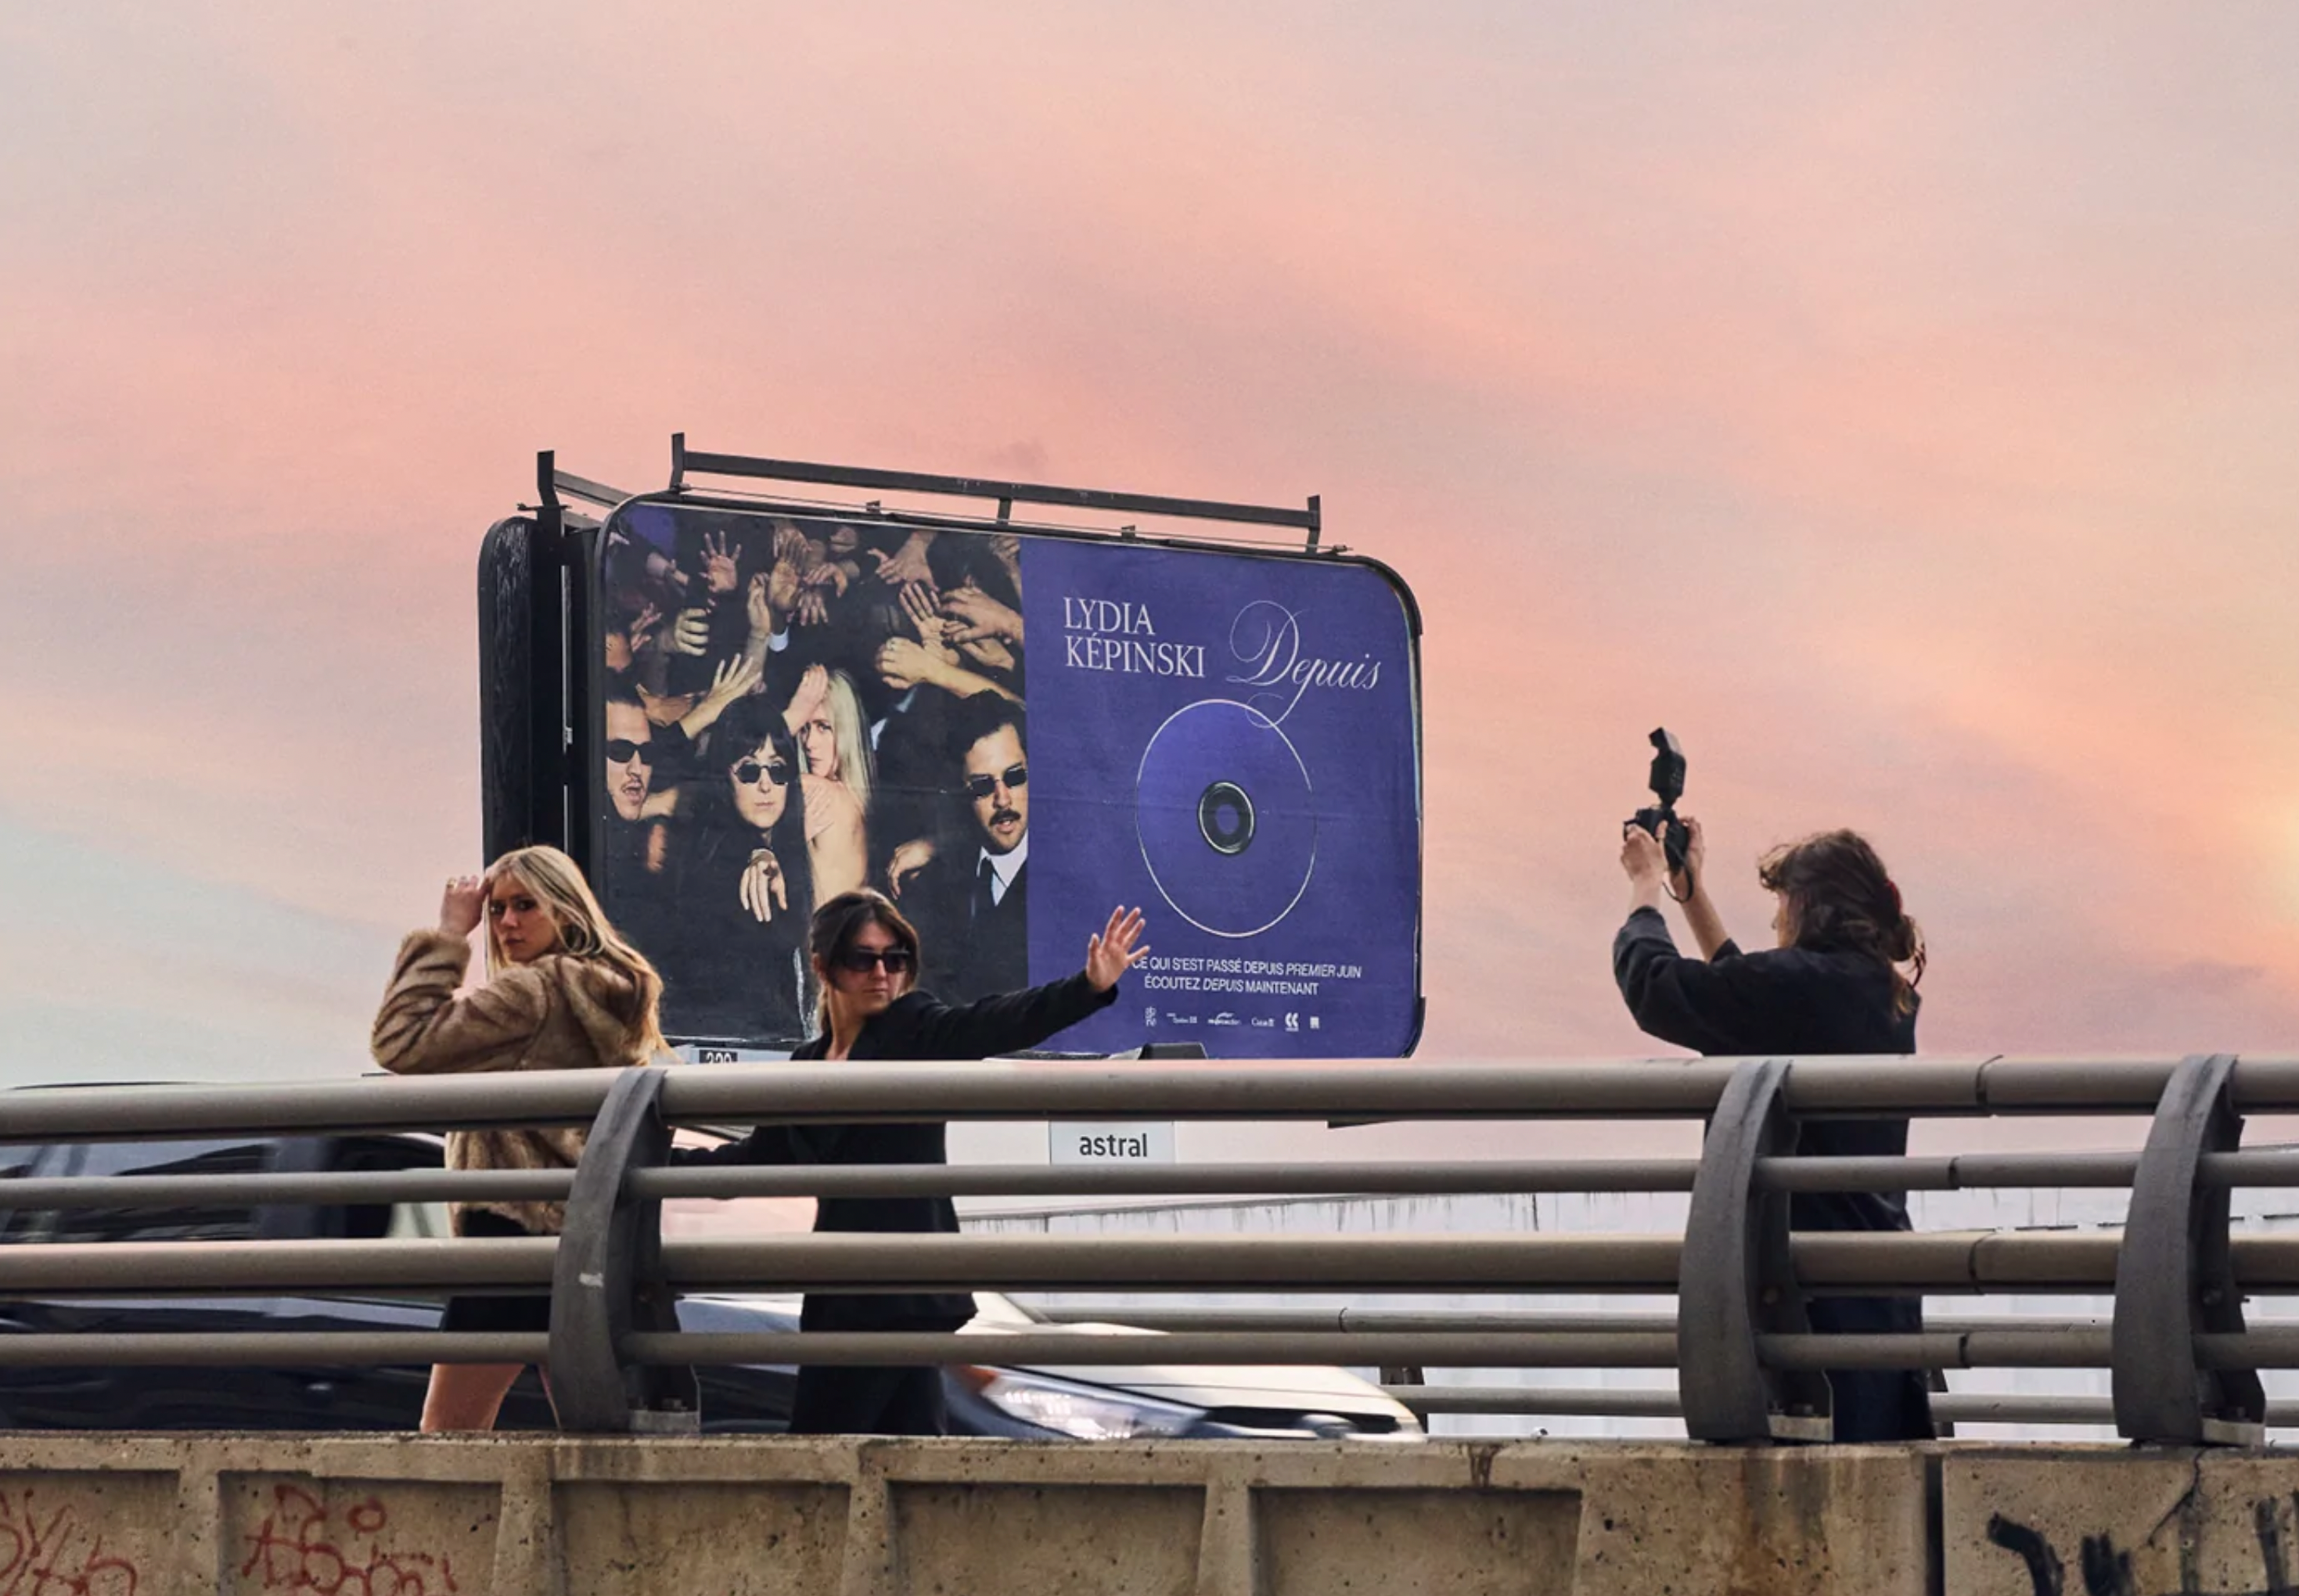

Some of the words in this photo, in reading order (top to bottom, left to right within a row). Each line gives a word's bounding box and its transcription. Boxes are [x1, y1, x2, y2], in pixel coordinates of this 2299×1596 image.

[1063, 597, 1156, 636] LYDIA
[1065, 632, 1206, 678] KÉPINSKI
[1225, 600, 1382, 728] Depuis
[1150, 956, 1171, 971] QUI
[1172, 957, 1204, 972] S'EST
[1206, 958, 1242, 973] PASSÉ
[1243, 961, 1284, 976] DEPUIS
[1285, 962, 1336, 977] PREMIER
[1337, 965, 1362, 978] JUIN
[1144, 972, 1200, 990] ÉCOUTEZ
[1203, 976, 1244, 993] DEPUIS
[1245, 980, 1319, 995] MAINTENANT
[1080, 1133, 1147, 1157] astral
